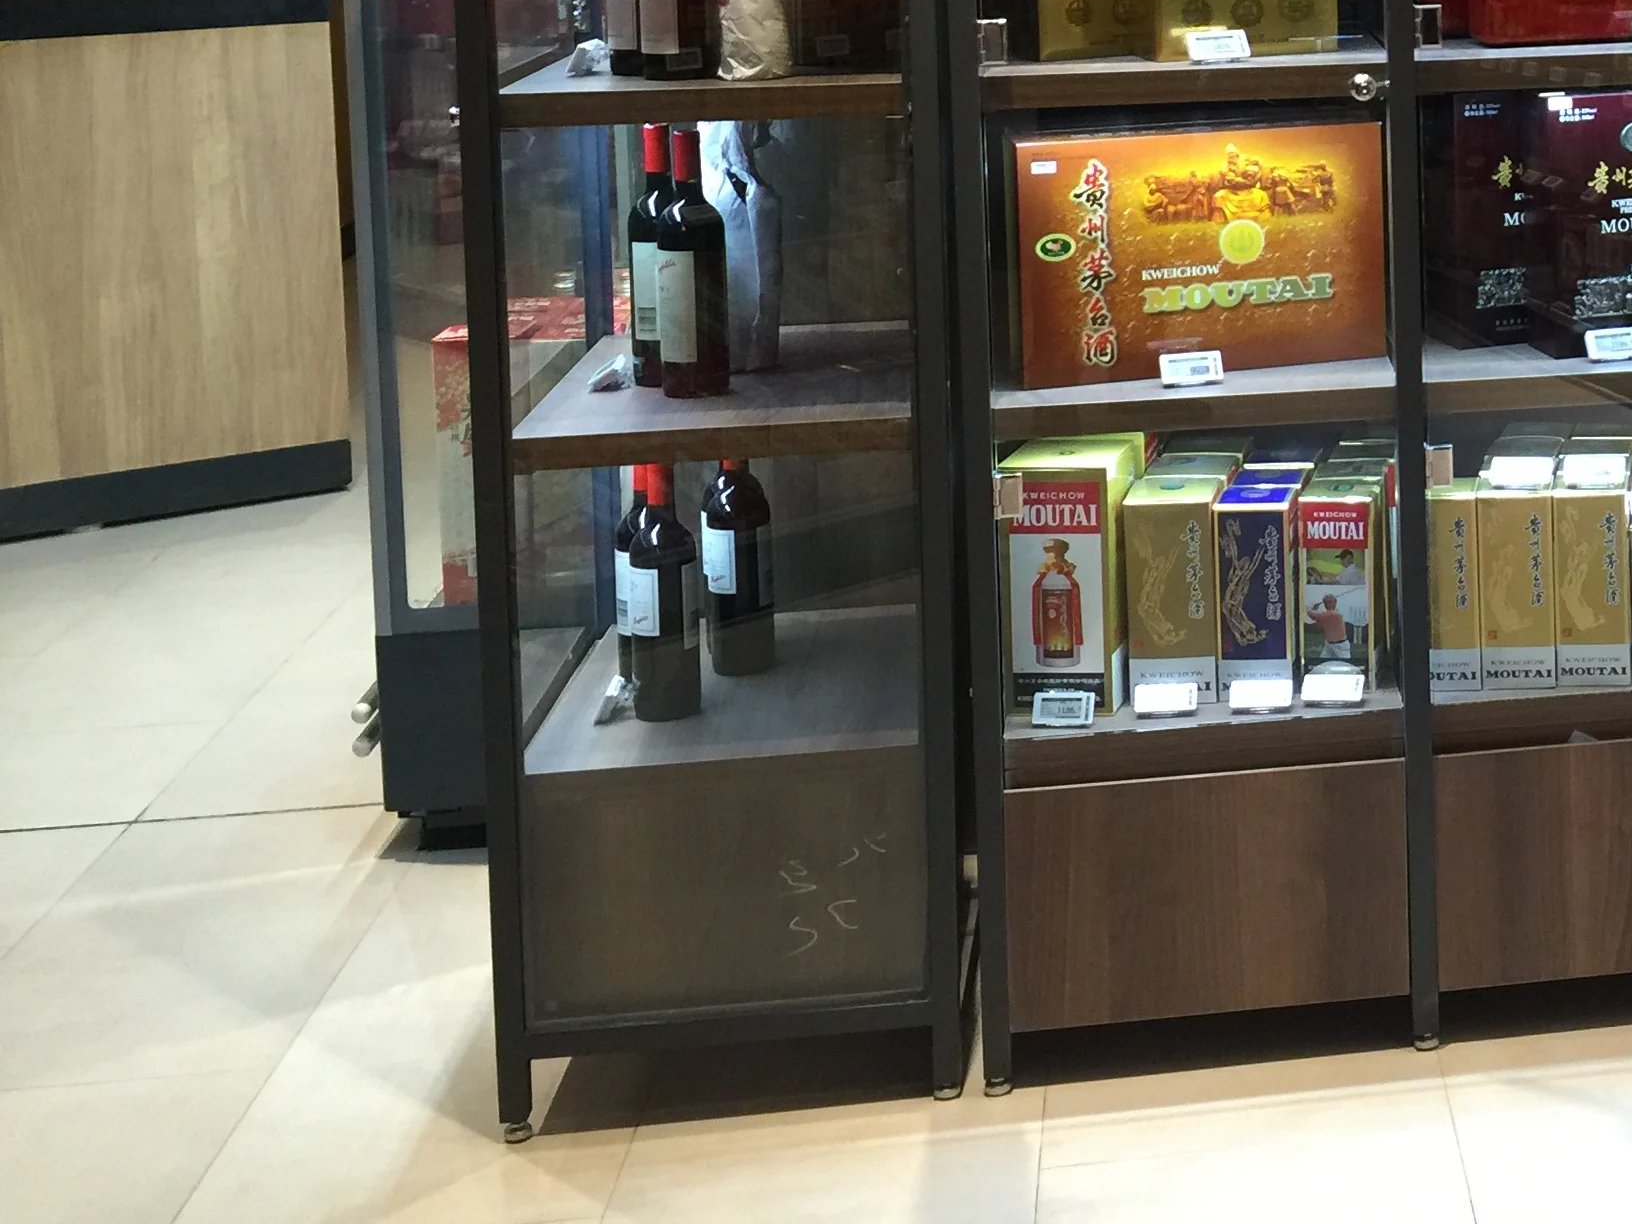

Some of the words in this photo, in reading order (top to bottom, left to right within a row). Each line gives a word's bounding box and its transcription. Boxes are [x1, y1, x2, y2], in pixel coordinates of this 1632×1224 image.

[1070, 159, 1118, 366] 贵州茅台酒
[1142, 265, 1220, 281] KWEICHOW
[1142, 274, 1334, 313] MOUTAI
[1022, 491, 1085, 500] KWEICHOW
[1013, 504, 1098, 527] MOUTAI
[1307, 520, 1365, 540] MOUTAI
[1449, 517, 1469, 609] 贵州茅台酒
[1524, 514, 1545, 607] 贵州茅台酒
[1599, 513, 1621, 605] 贵州茅台酒
[1485, 669, 1552, 679] MOUTAI
[1560, 666, 1628, 677] MOUTAI
